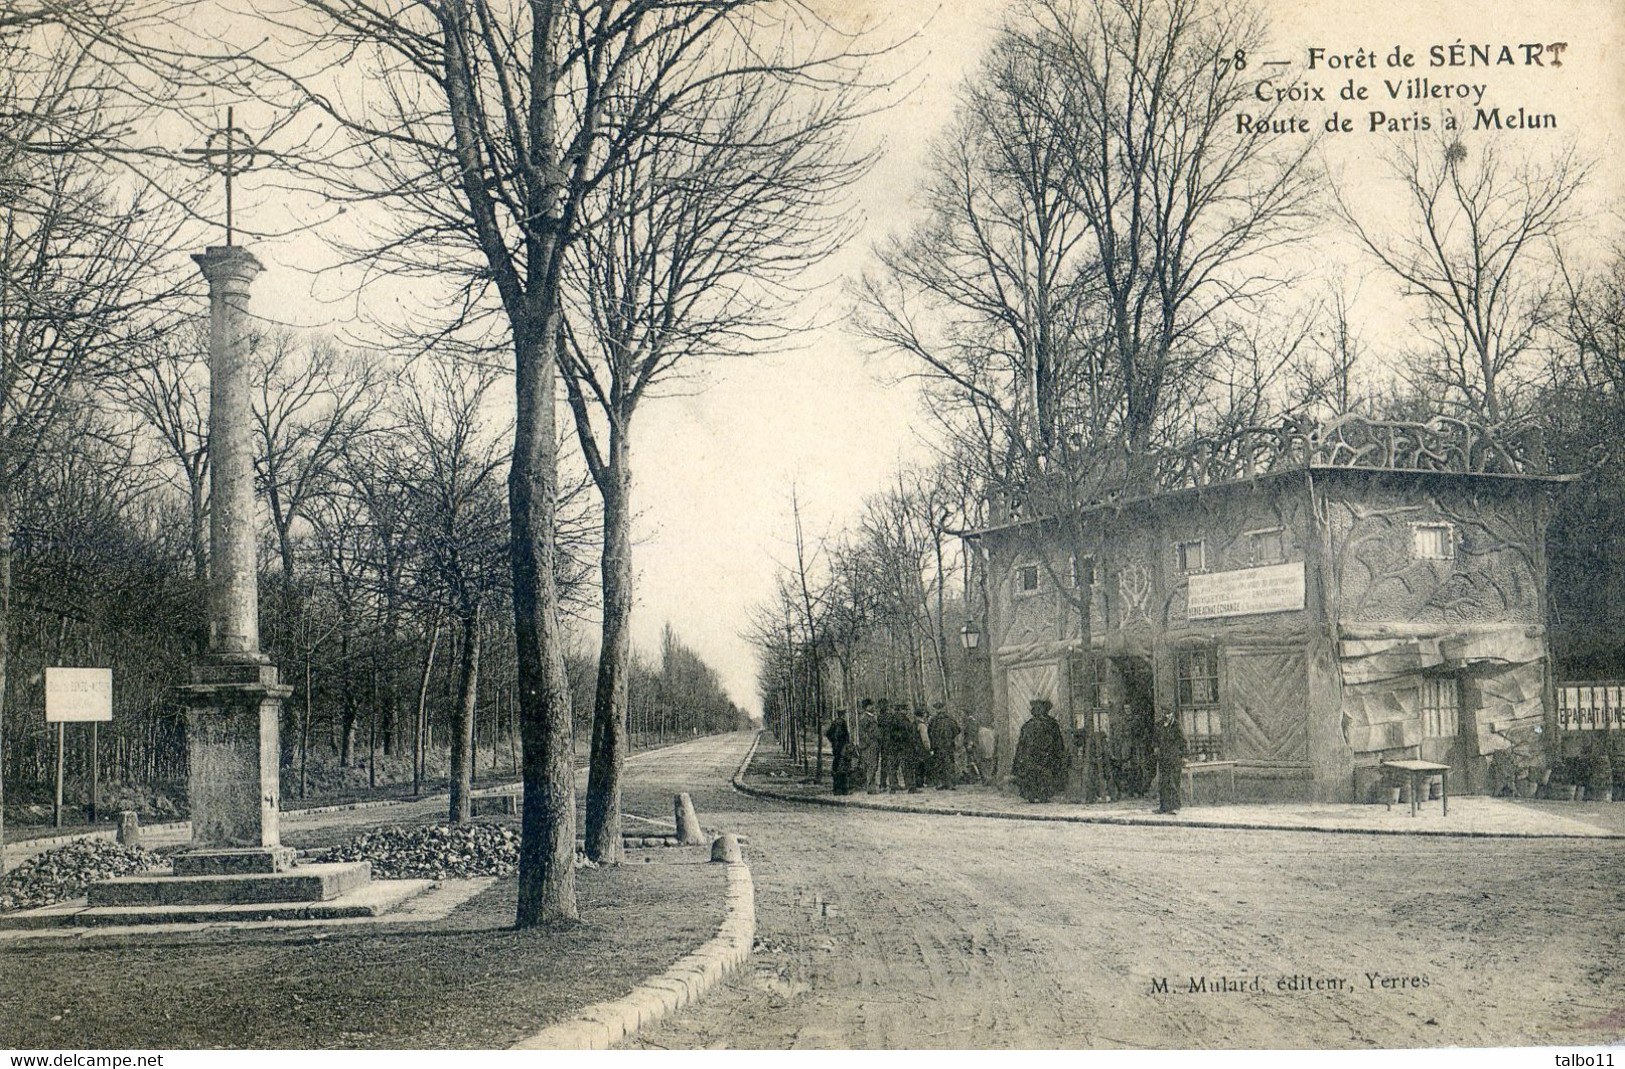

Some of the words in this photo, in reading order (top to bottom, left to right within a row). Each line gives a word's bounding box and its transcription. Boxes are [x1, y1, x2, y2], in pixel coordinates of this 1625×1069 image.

[1219, 49, 1247, 76] 78
[1309, 48, 1376, 69] Forêt
[1387, 46, 1414, 67] de
[1431, 39, 1567, 66] SÉNART
[1254, 80, 1325, 101] Croix
[1341, 80, 1368, 100] de
[1385, 78, 1486, 106] Villeroy
[1235, 113, 1310, 134] Route
[1325, 112, 1353, 132] de
[1370, 112, 1430, 131] Paris
[1444, 108, 1457, 130] à
[1473, 108, 1556, 129] Melun
[1150, 978, 1177, 993] M.
[1188, 976, 1266, 993] Mulard,
[1365, 972, 1430, 988] Yerres
